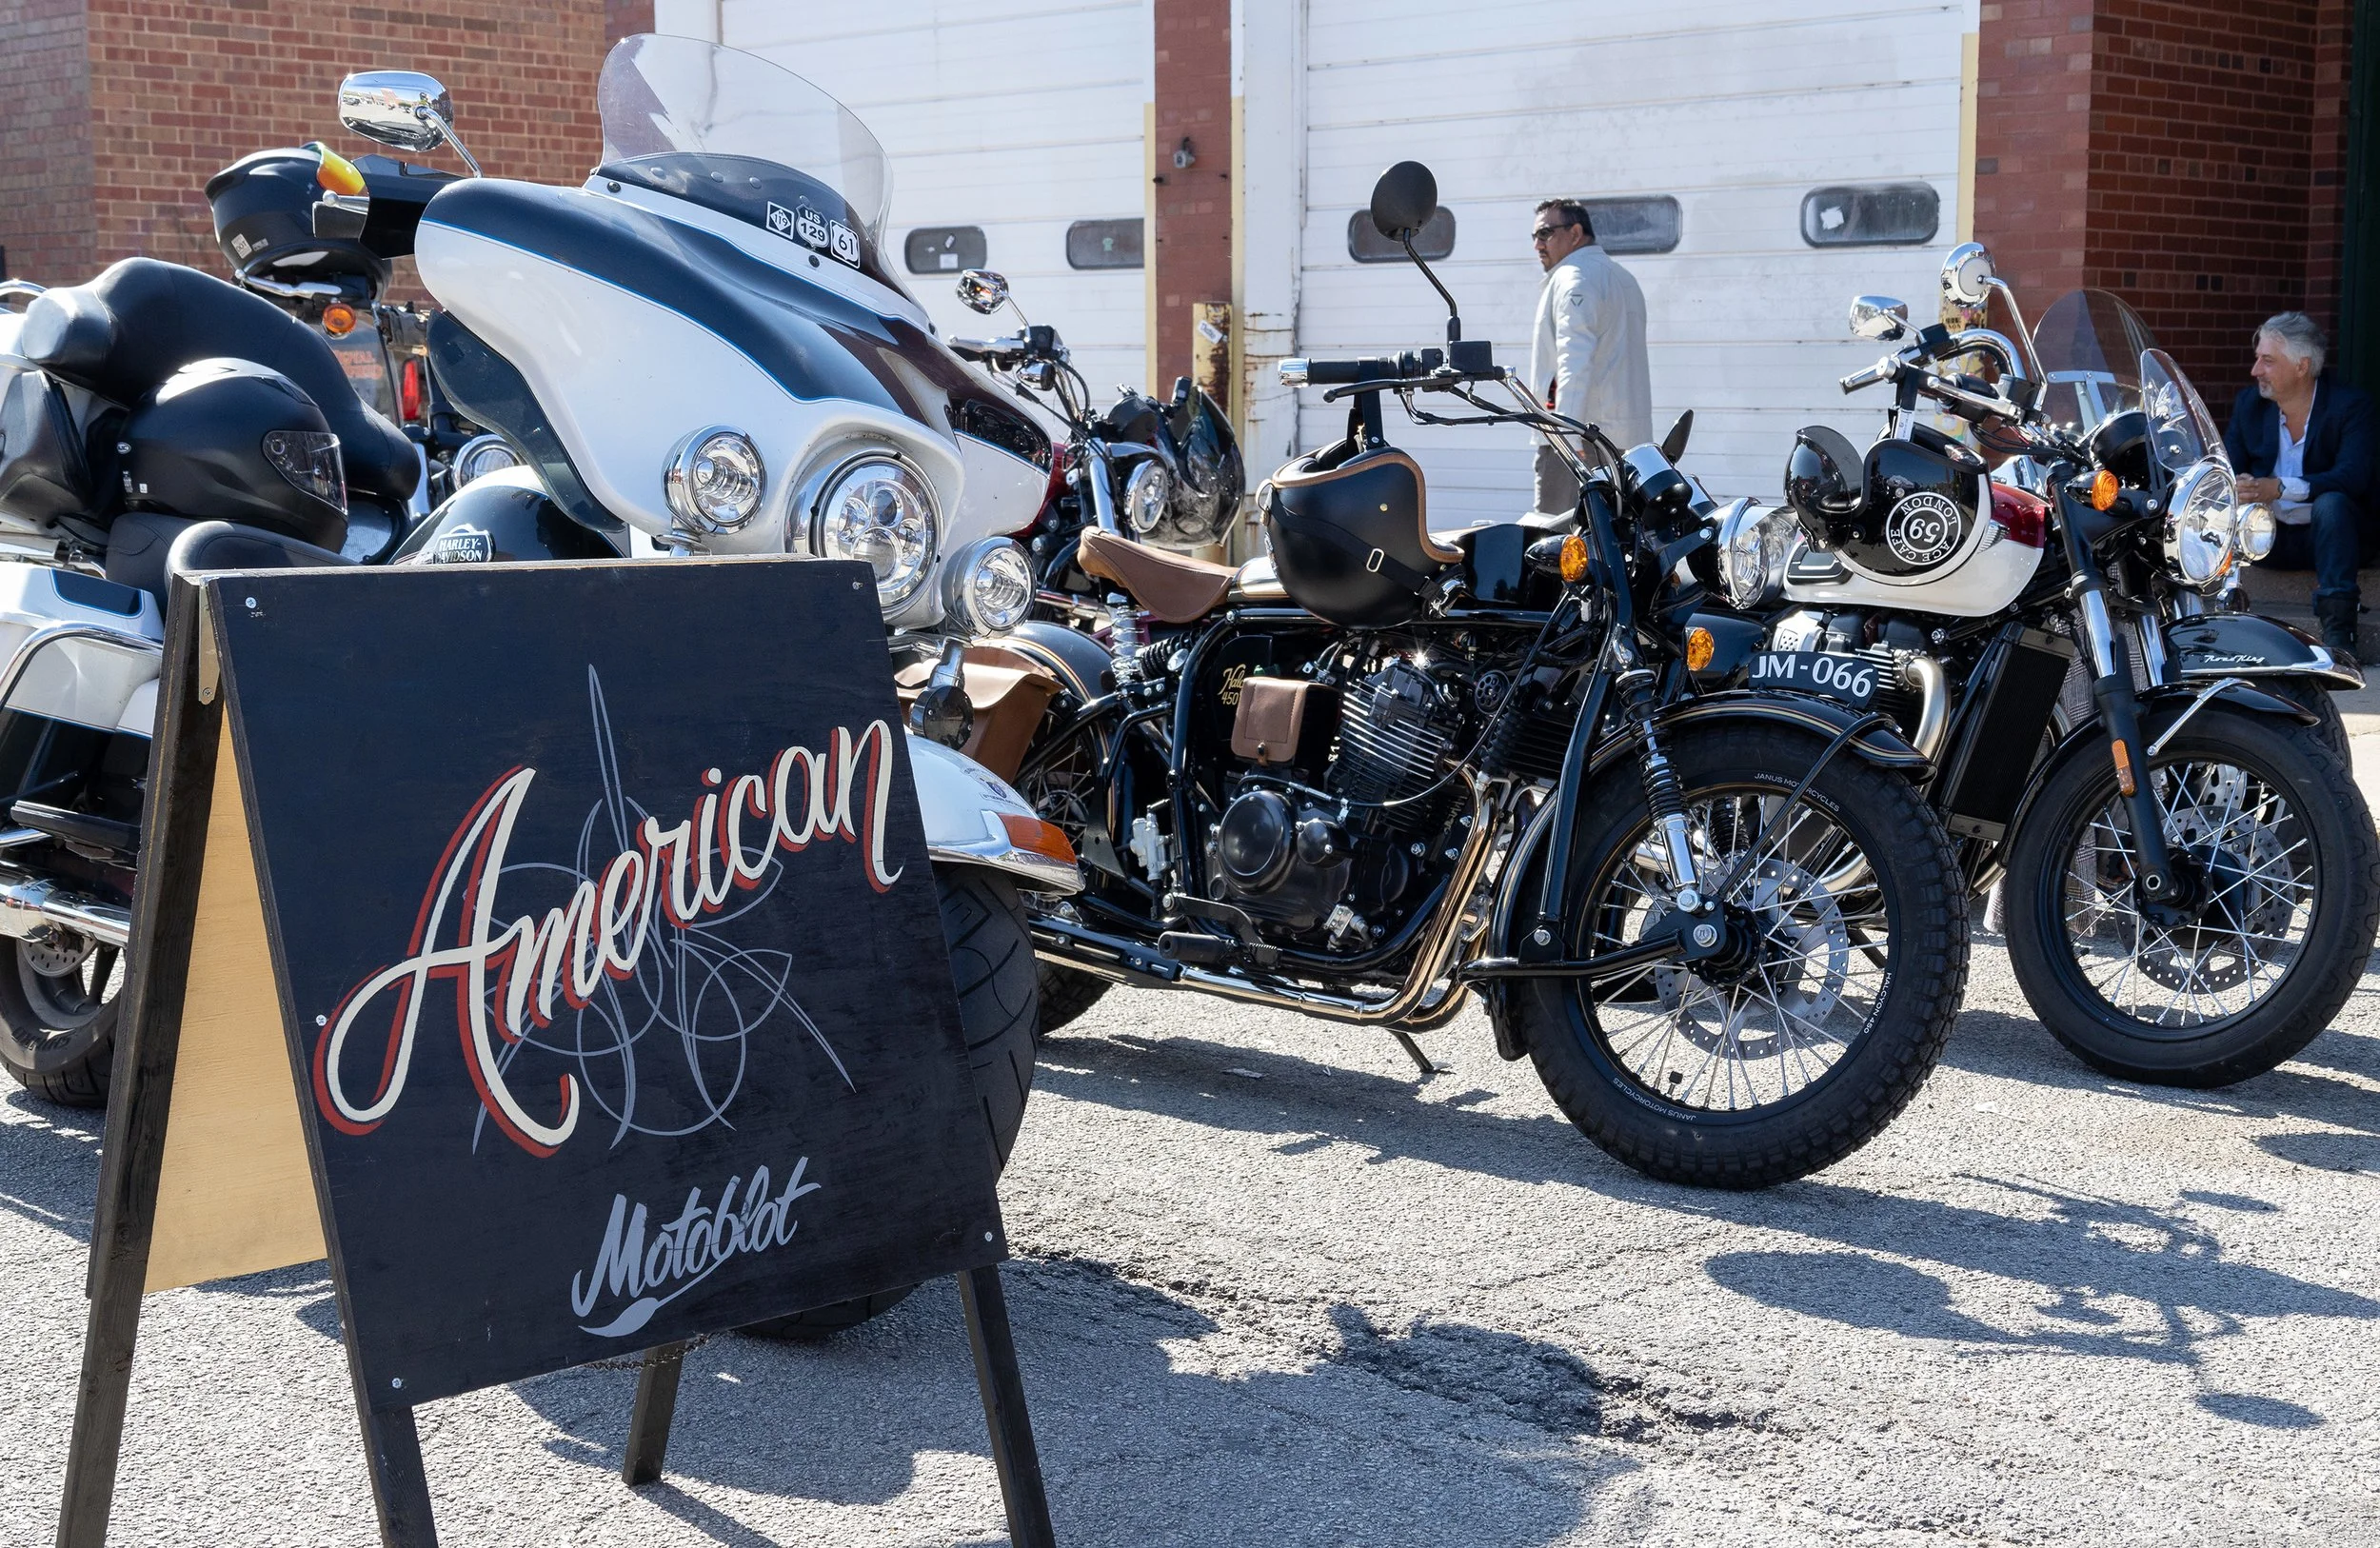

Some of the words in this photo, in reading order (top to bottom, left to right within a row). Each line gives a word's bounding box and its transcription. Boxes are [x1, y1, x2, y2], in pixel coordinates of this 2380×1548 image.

[772, 213, 789, 227] 119
[804, 209, 822, 224] US
[801, 222, 825, 242] 129
[838, 233, 854, 255] 61
[1900, 496, 1957, 526] LONDON
[1909, 518, 1941, 544] 59
[438, 538, 482, 551] HARLEY-
[1890, 528, 1916, 560] CAFE
[1922, 541, 1951, 562] ACE
[1752, 654, 1874, 698] JM-066
[1220, 691, 1240, 705] 450
[1754, 772, 1783, 784] JANUS
[1783, 778, 1840, 812] MORCYCLES
[315, 720, 903, 1158] American
[1873, 972, 1893, 1017] HALCYON
[1863, 1017, 1875, 1034] 450
[1613, 1077, 1666, 1115] MOTORCYCLES
[1668, 1109, 1696, 1121] JANUS
[572, 1156, 822, 1318] Motoblot
